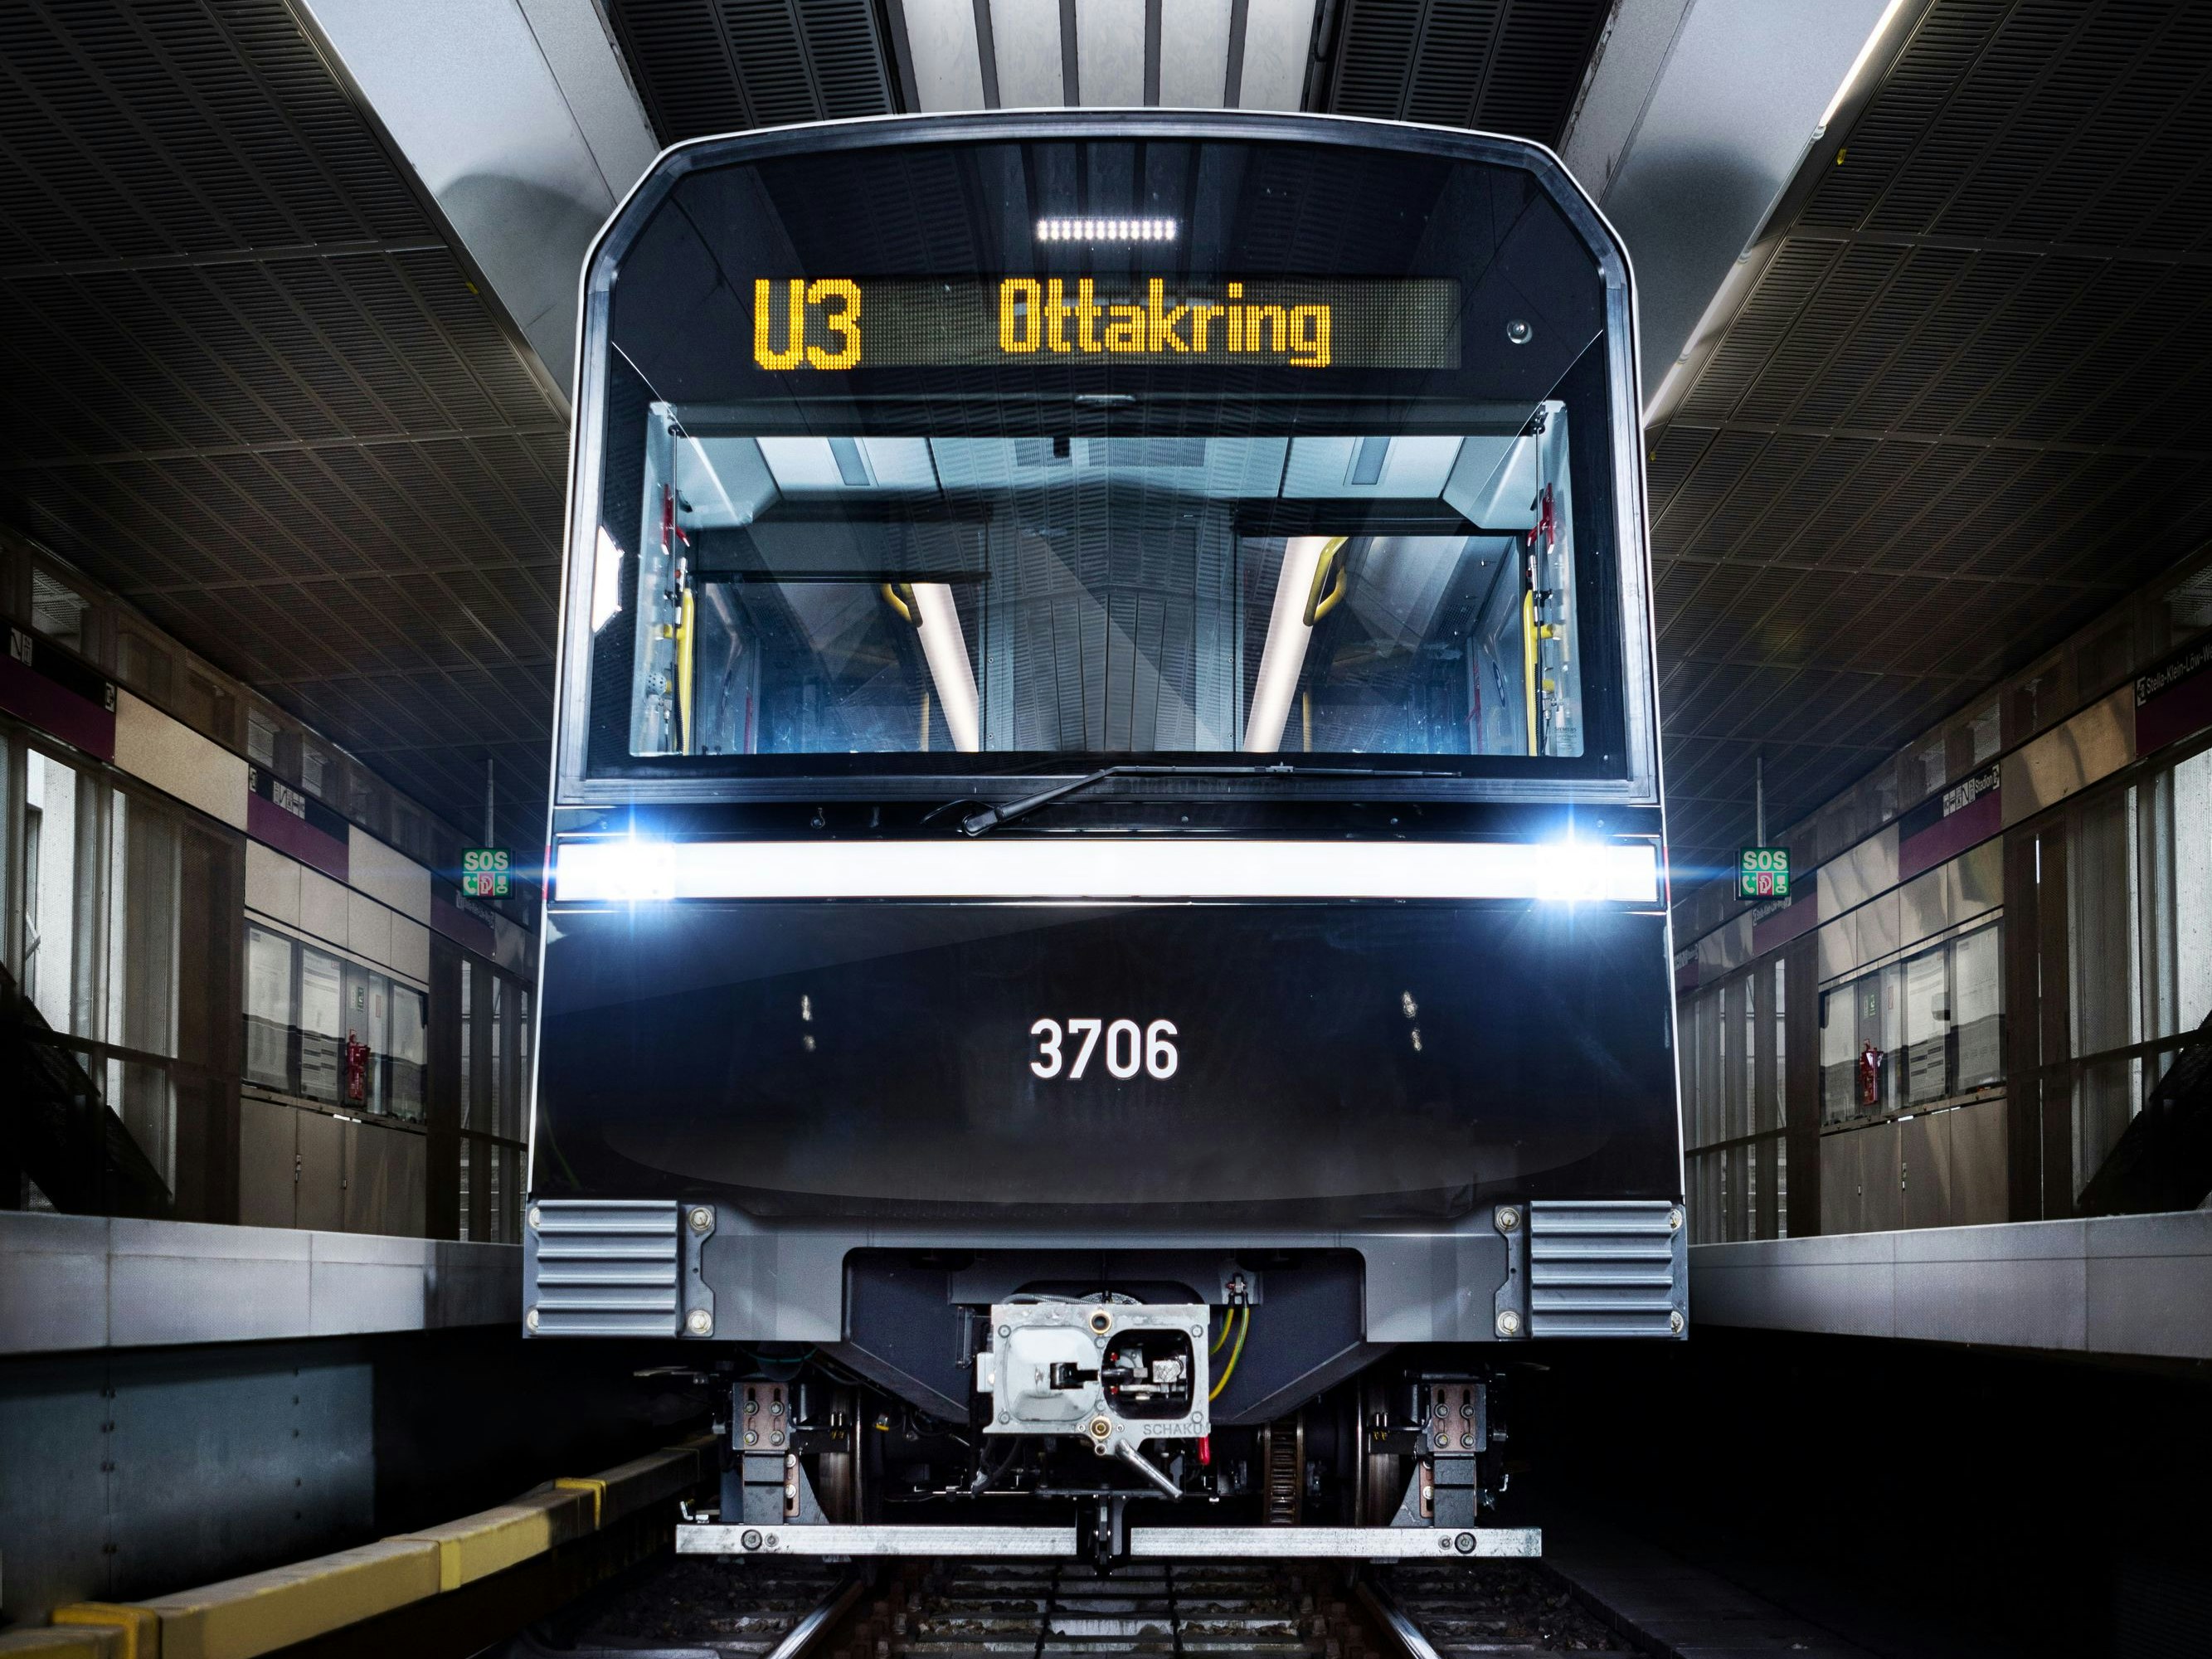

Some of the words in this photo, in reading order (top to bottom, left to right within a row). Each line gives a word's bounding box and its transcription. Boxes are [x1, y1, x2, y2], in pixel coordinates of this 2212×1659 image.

[755, 279, 861, 370] U3
[1000, 278, 1330, 367] Ottakring
[464, 851, 508, 871] SOS
[1743, 851, 1787, 870] SOS
[1030, 1019, 1179, 1079] 3706
